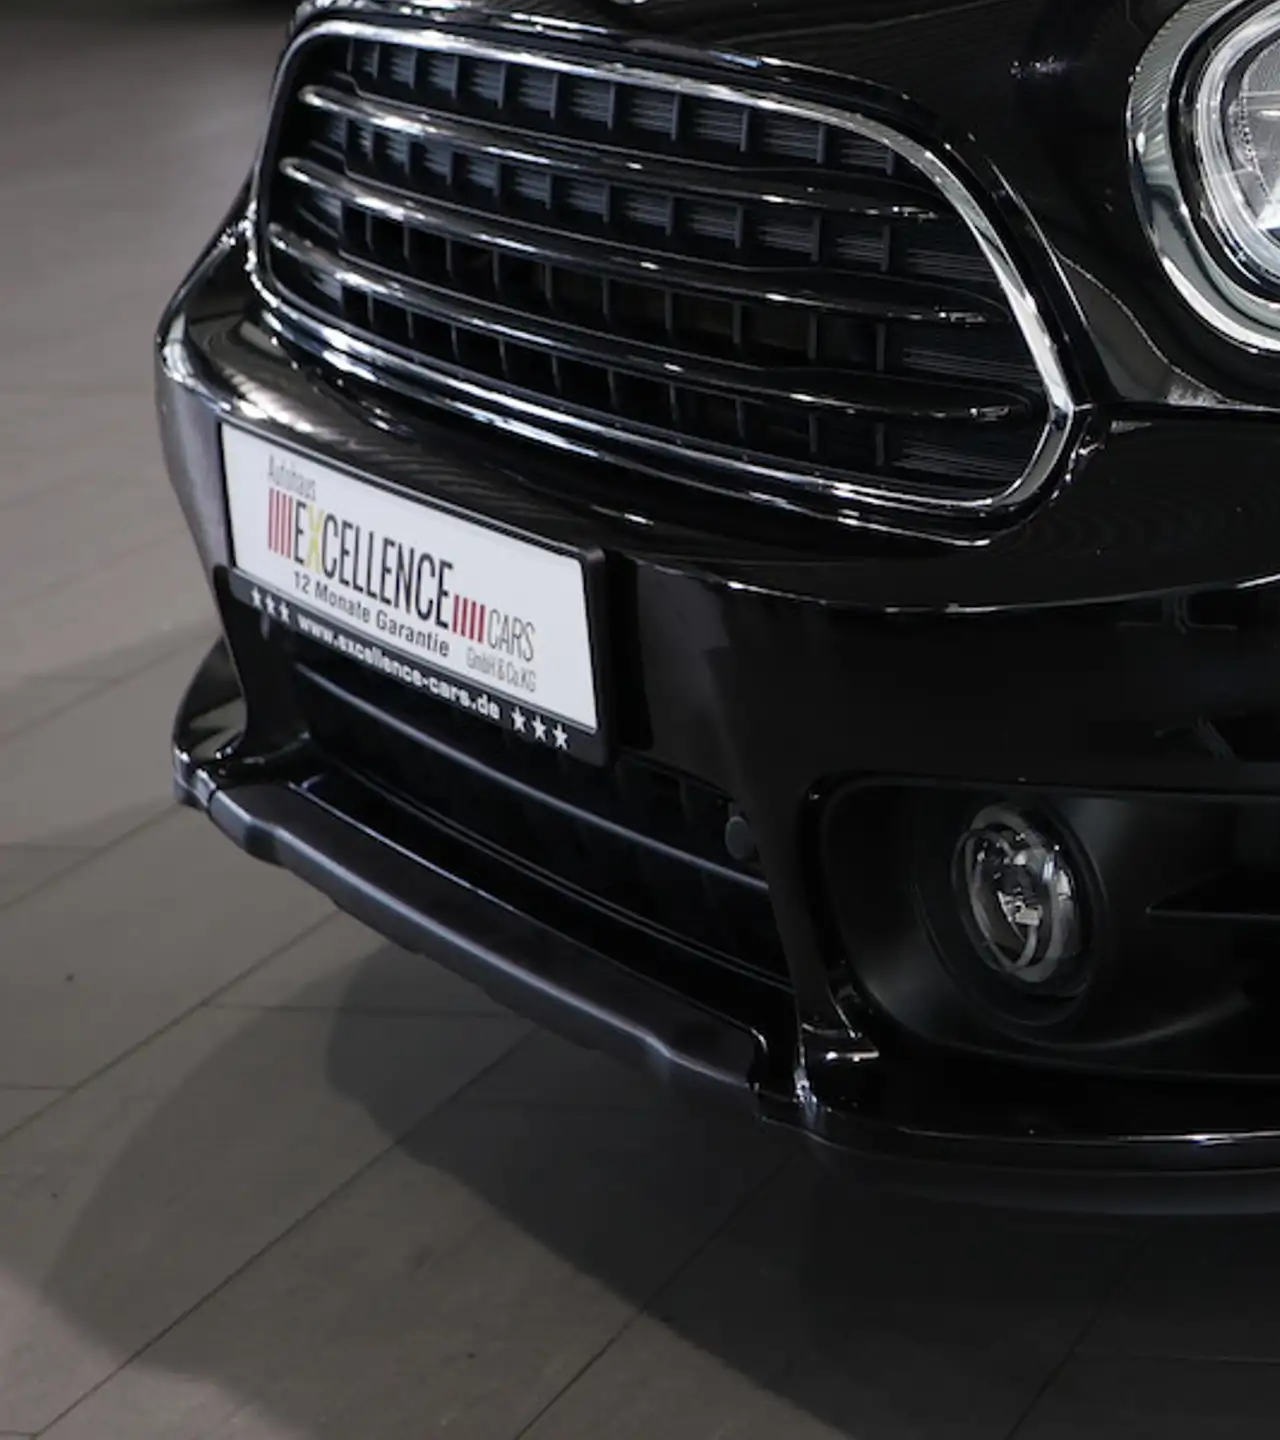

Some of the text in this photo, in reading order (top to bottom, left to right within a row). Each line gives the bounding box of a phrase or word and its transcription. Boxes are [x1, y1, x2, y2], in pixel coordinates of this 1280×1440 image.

[293, 499, 536, 662] EXCELLENCE CARS
[294, 570, 450, 658] 12 Monate Garantie
[297, 613, 500, 720] www.excellence-cars.de
